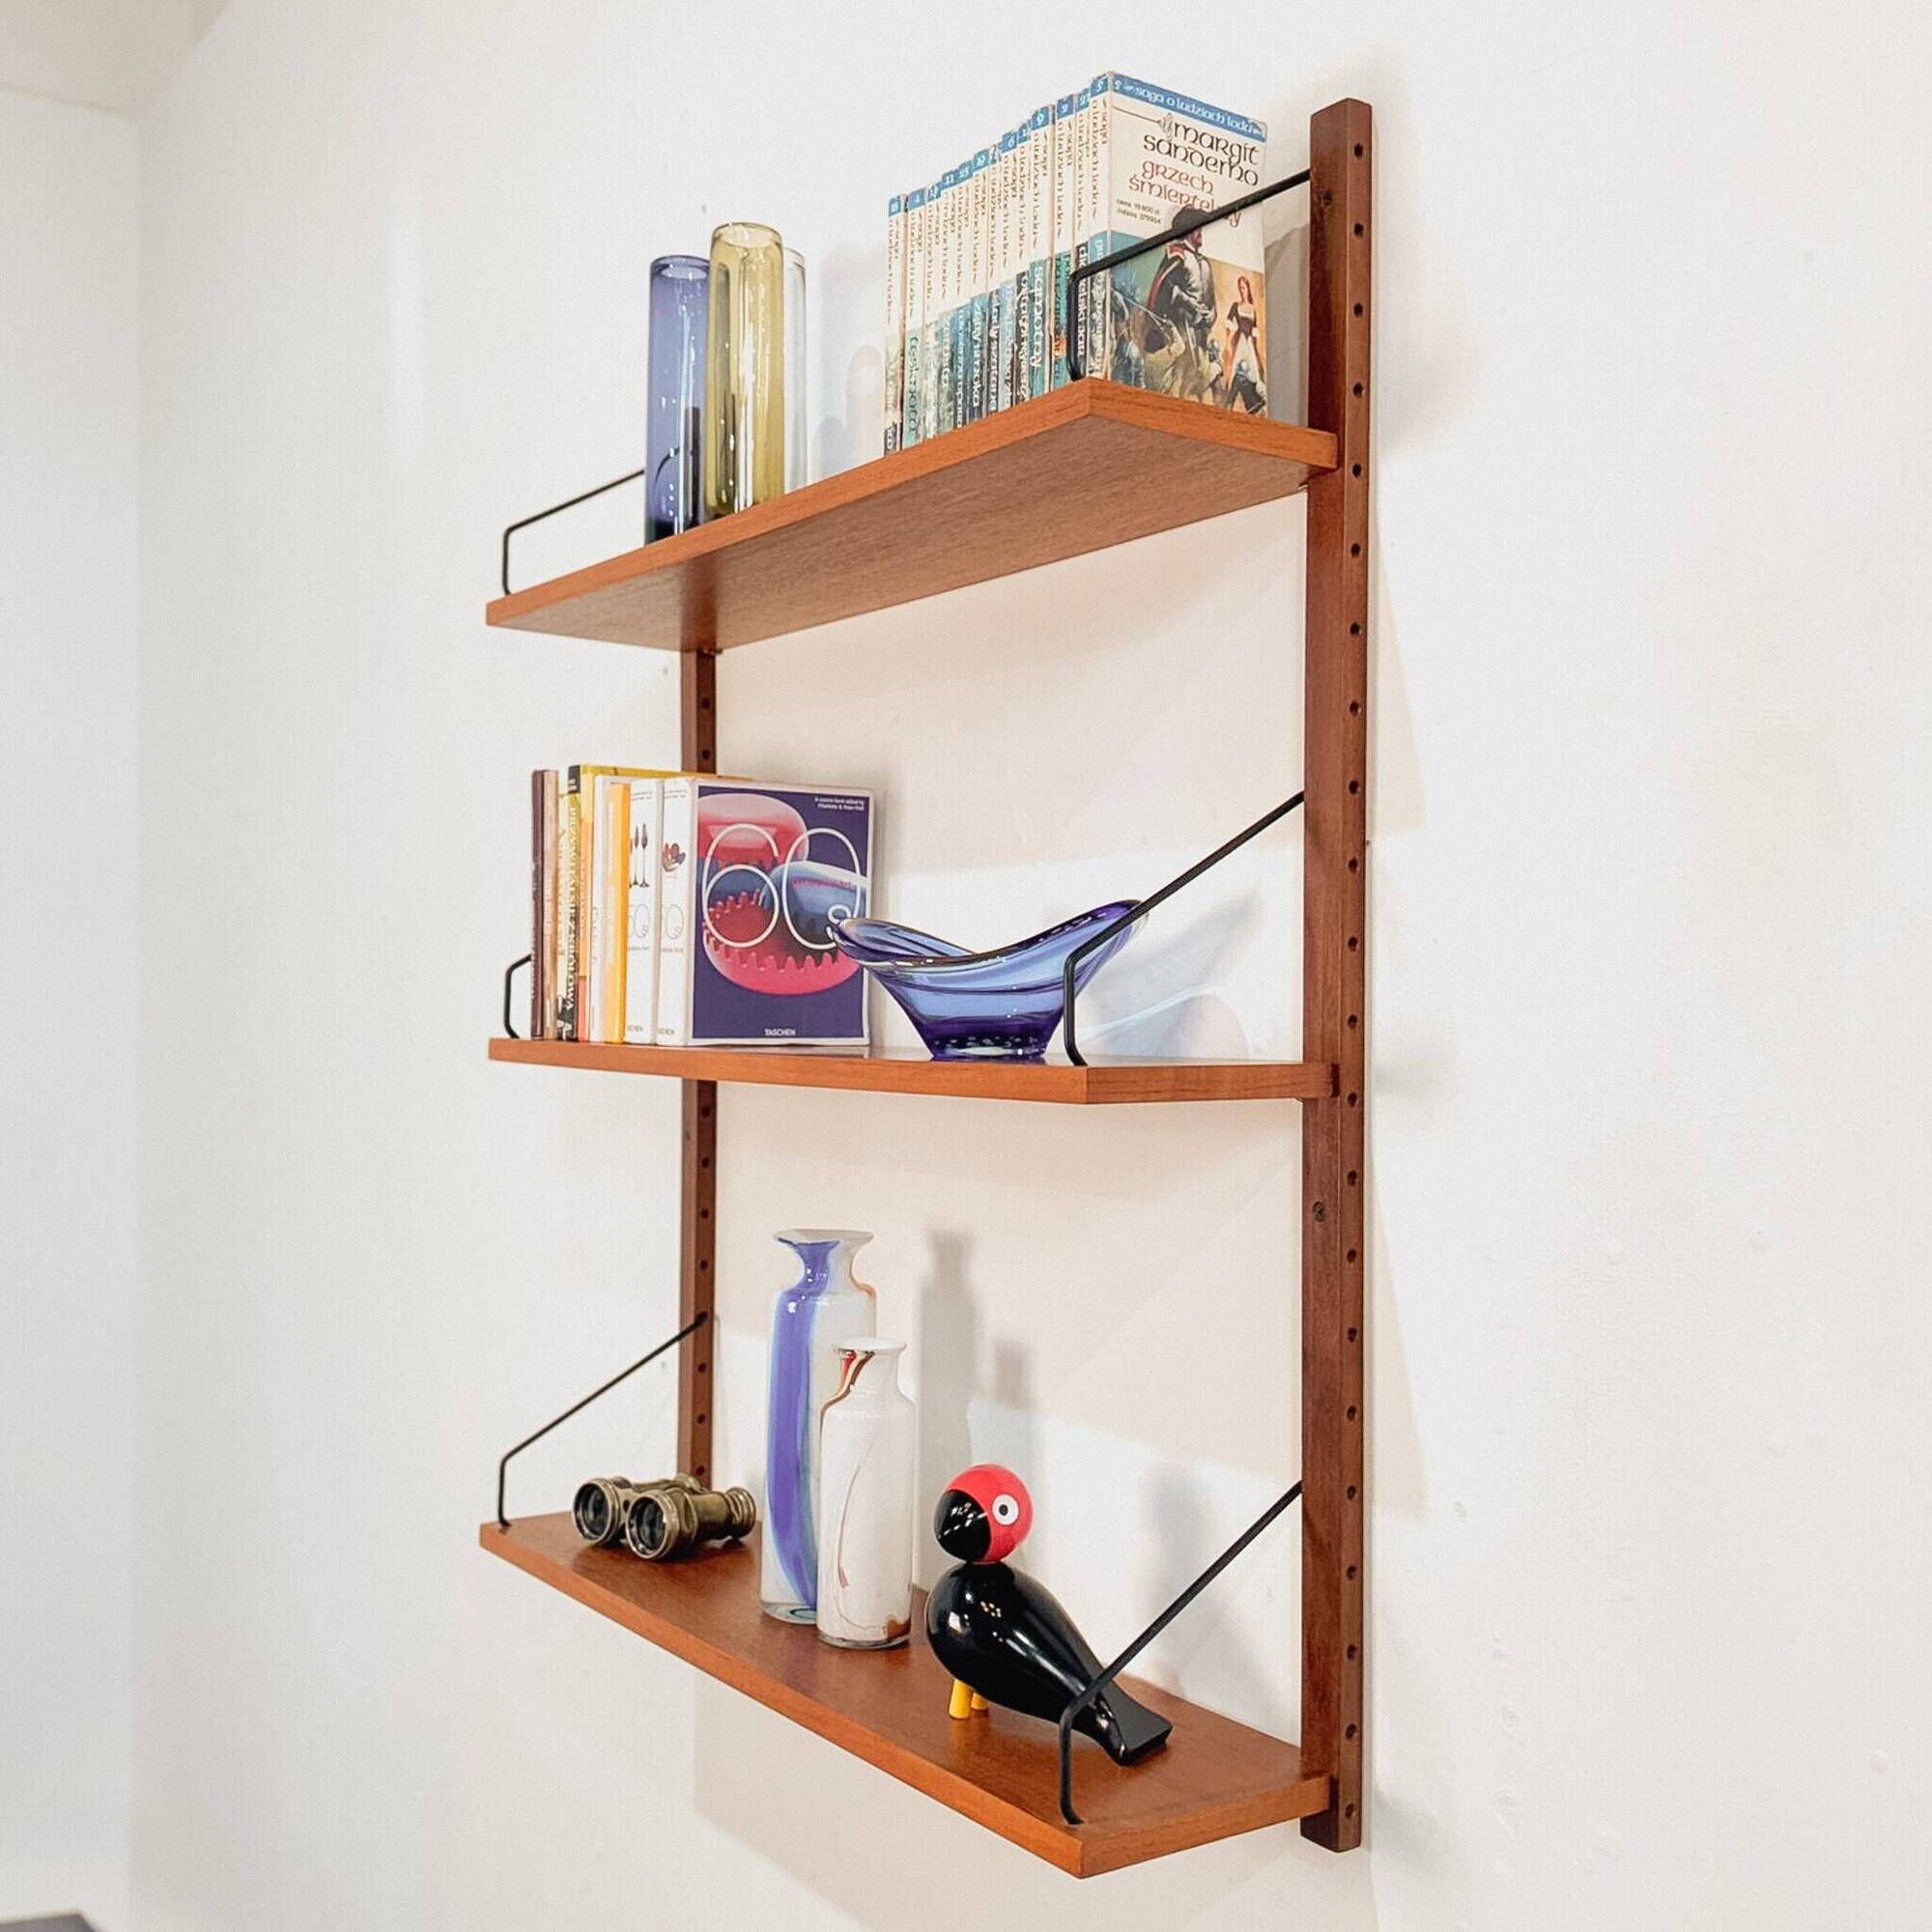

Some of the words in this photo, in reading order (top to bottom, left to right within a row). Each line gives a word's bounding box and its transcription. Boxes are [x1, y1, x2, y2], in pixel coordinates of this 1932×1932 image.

[1136, 86, 1163, 103] saga
[1166, 96, 1176, 106] o
[1177, 99, 1226, 127] ludziach
[1143, 133, 1260, 186] sandemo
[1175, 121, 1260, 166] margit
[1142, 160, 1214, 195] grzech
[1029, 266, 1043, 367] samotny
[764, 1028, 796, 1037] TASCHEN
